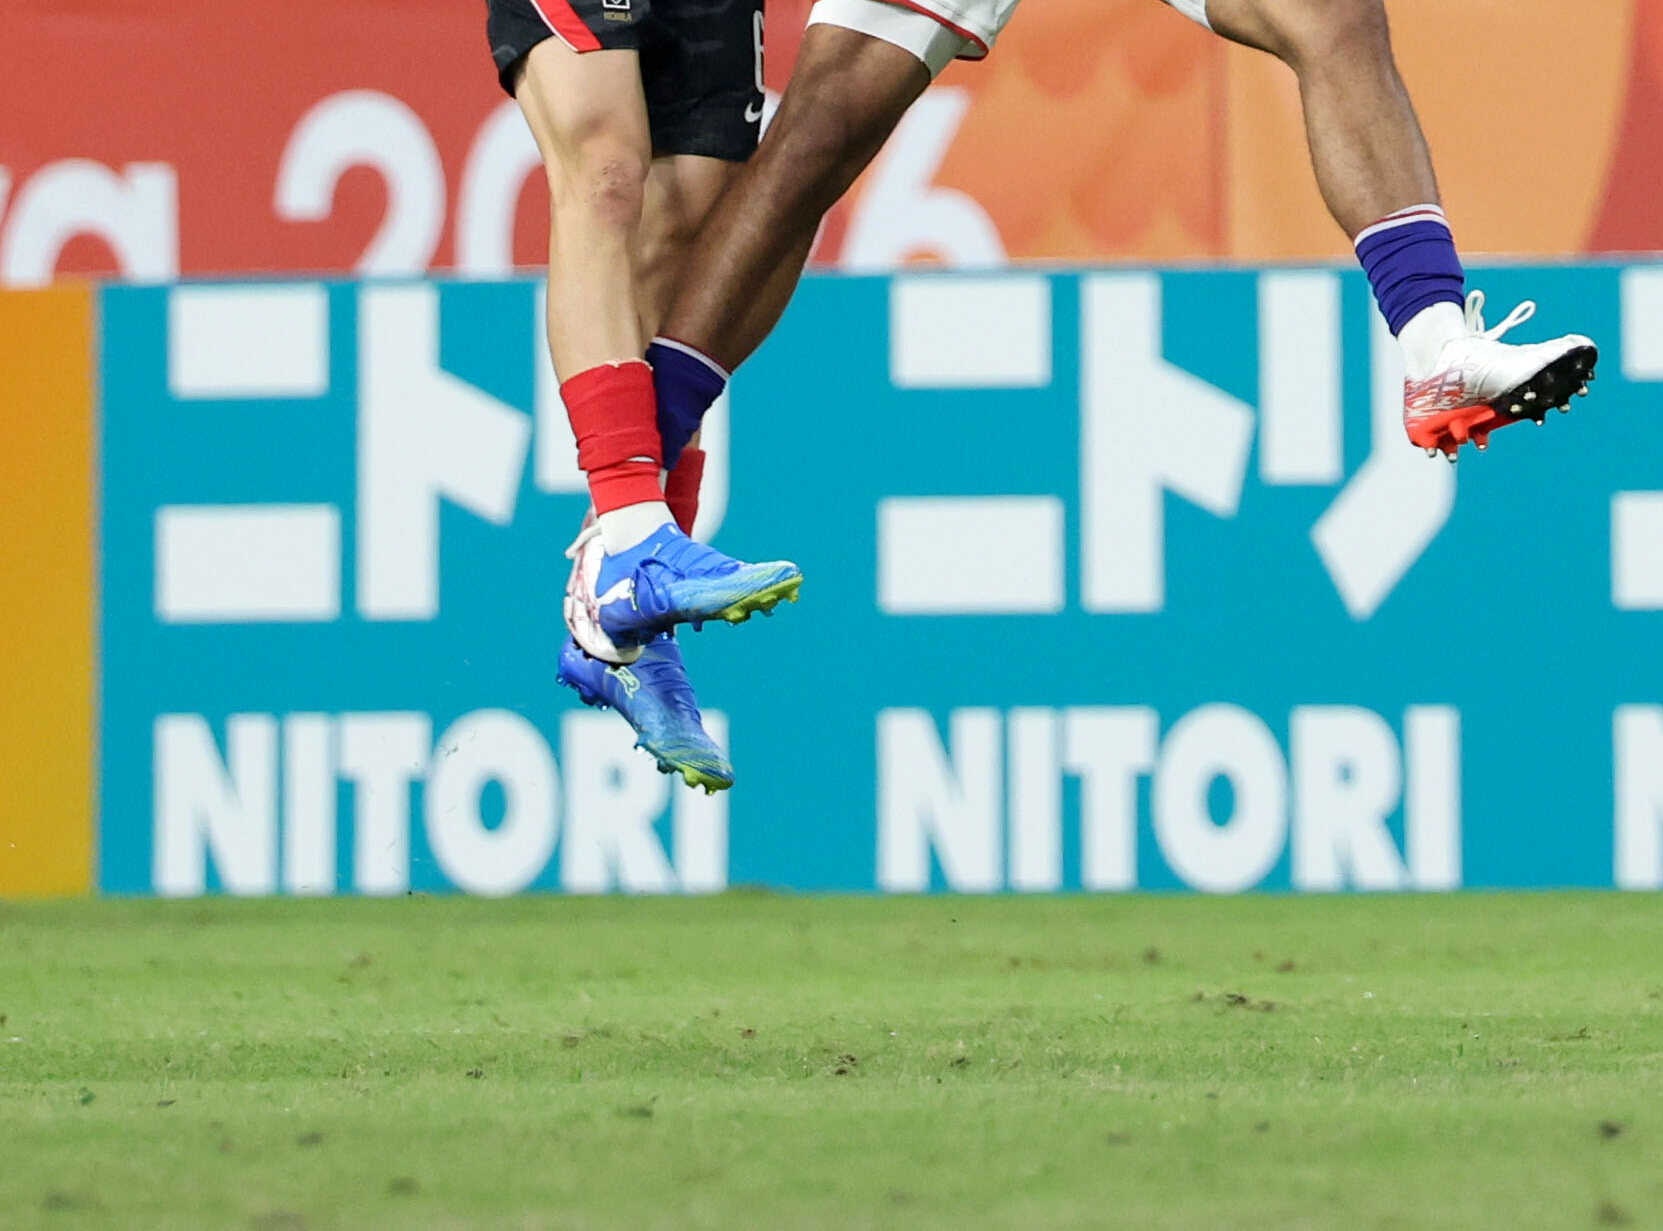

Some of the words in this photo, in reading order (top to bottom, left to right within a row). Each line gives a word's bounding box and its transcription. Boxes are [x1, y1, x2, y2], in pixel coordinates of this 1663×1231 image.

[272, 87, 1012, 277] 26
[876, 269, 1457, 623] ニトリ
[153, 708, 730, 897] NITORI
[875, 703, 1462, 894] NITORI
